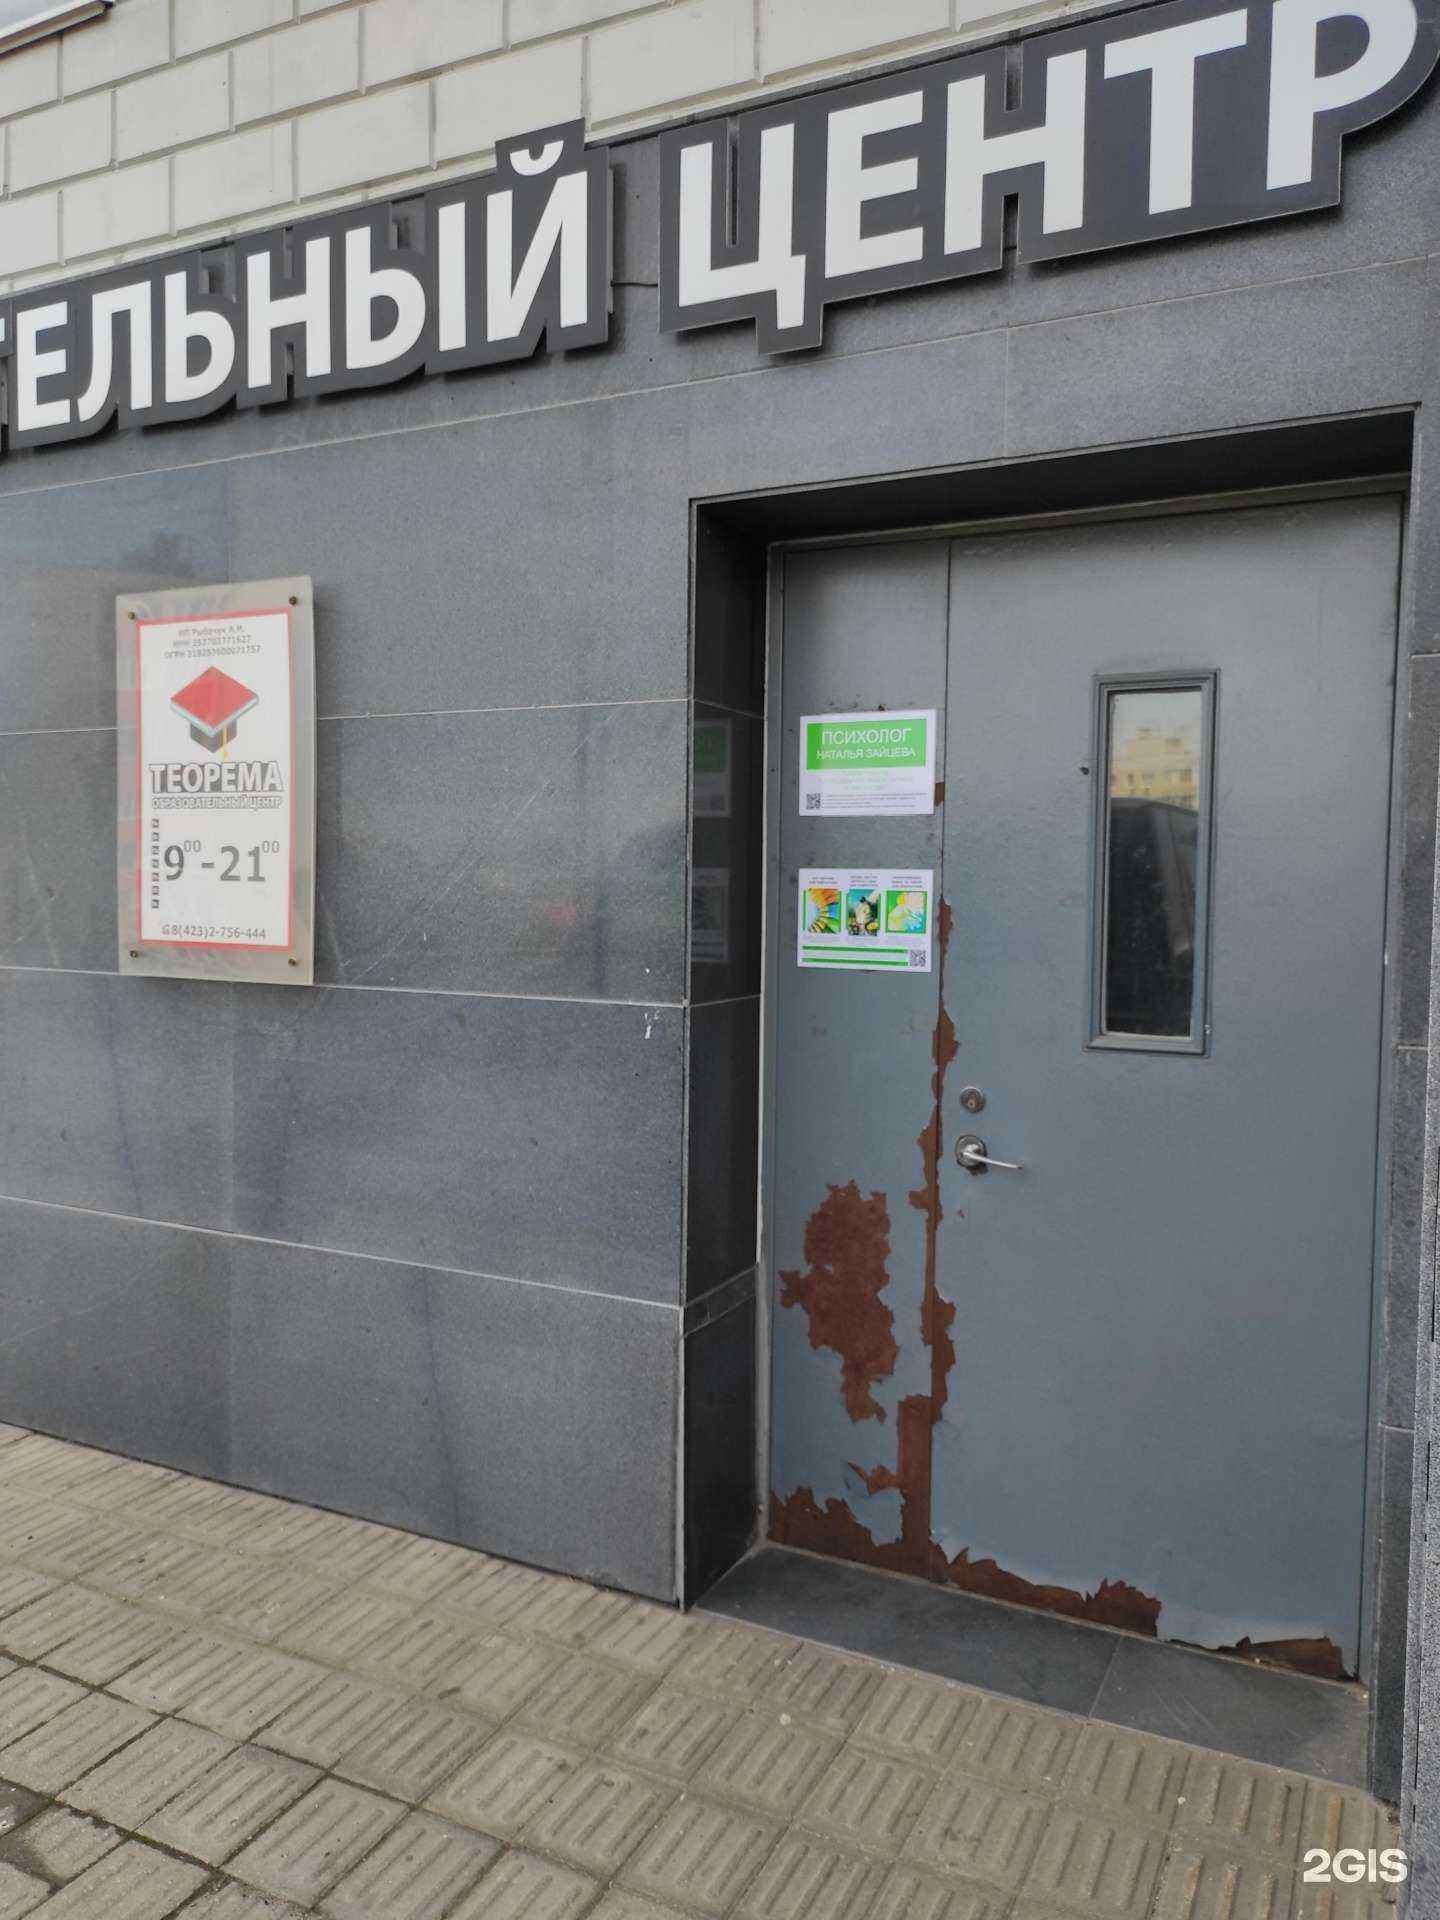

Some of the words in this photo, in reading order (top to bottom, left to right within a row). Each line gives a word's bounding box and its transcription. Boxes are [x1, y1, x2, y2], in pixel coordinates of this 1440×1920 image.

[0, 140, 588, 432] ЕЛЬНЫЙ
[678, 0, 1418, 329] ЦЕНТР
[821, 728, 912, 745] ПСИХОЛОГ
[816, 749, 864, 760] НАТАЛЬЯ
[149, 761, 284, 793] ТЕОРЕМА
